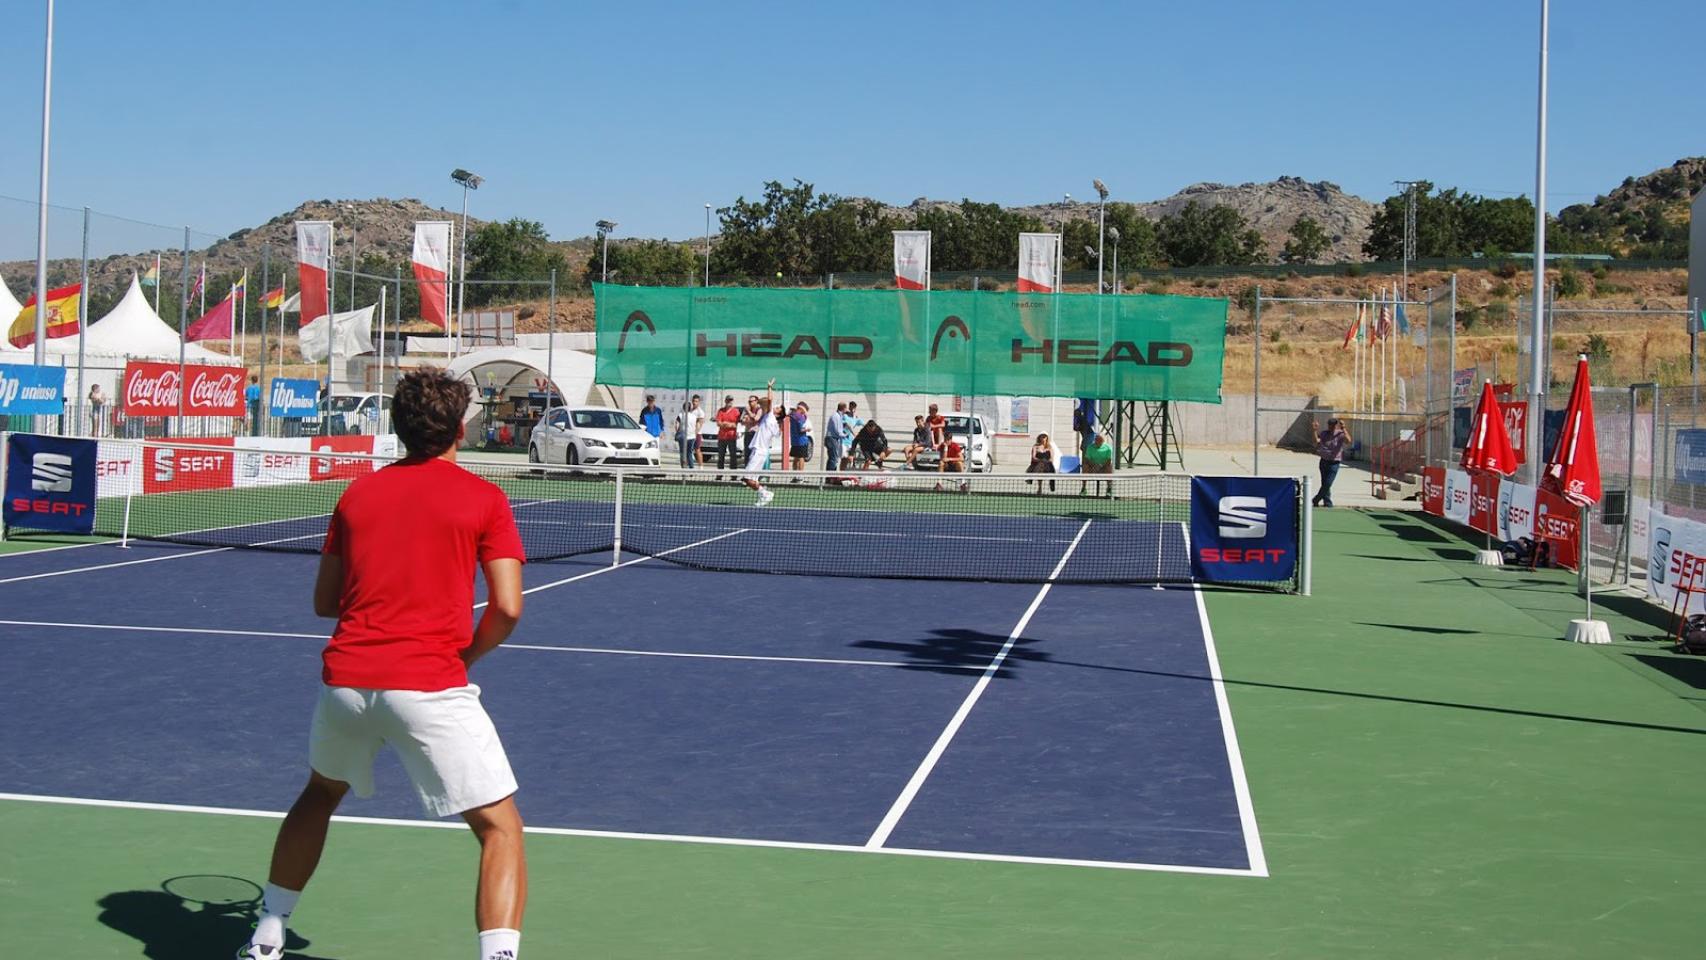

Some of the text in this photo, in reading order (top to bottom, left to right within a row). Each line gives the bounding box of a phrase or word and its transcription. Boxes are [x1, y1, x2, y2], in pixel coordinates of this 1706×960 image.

[696, 332, 874, 361] HEAD
[1011, 338, 1194, 367] HEAD
[179, 456, 225, 472] SEAT
[12, 498, 87, 517] SEAT
[1200, 547, 1287, 564] SEAT
